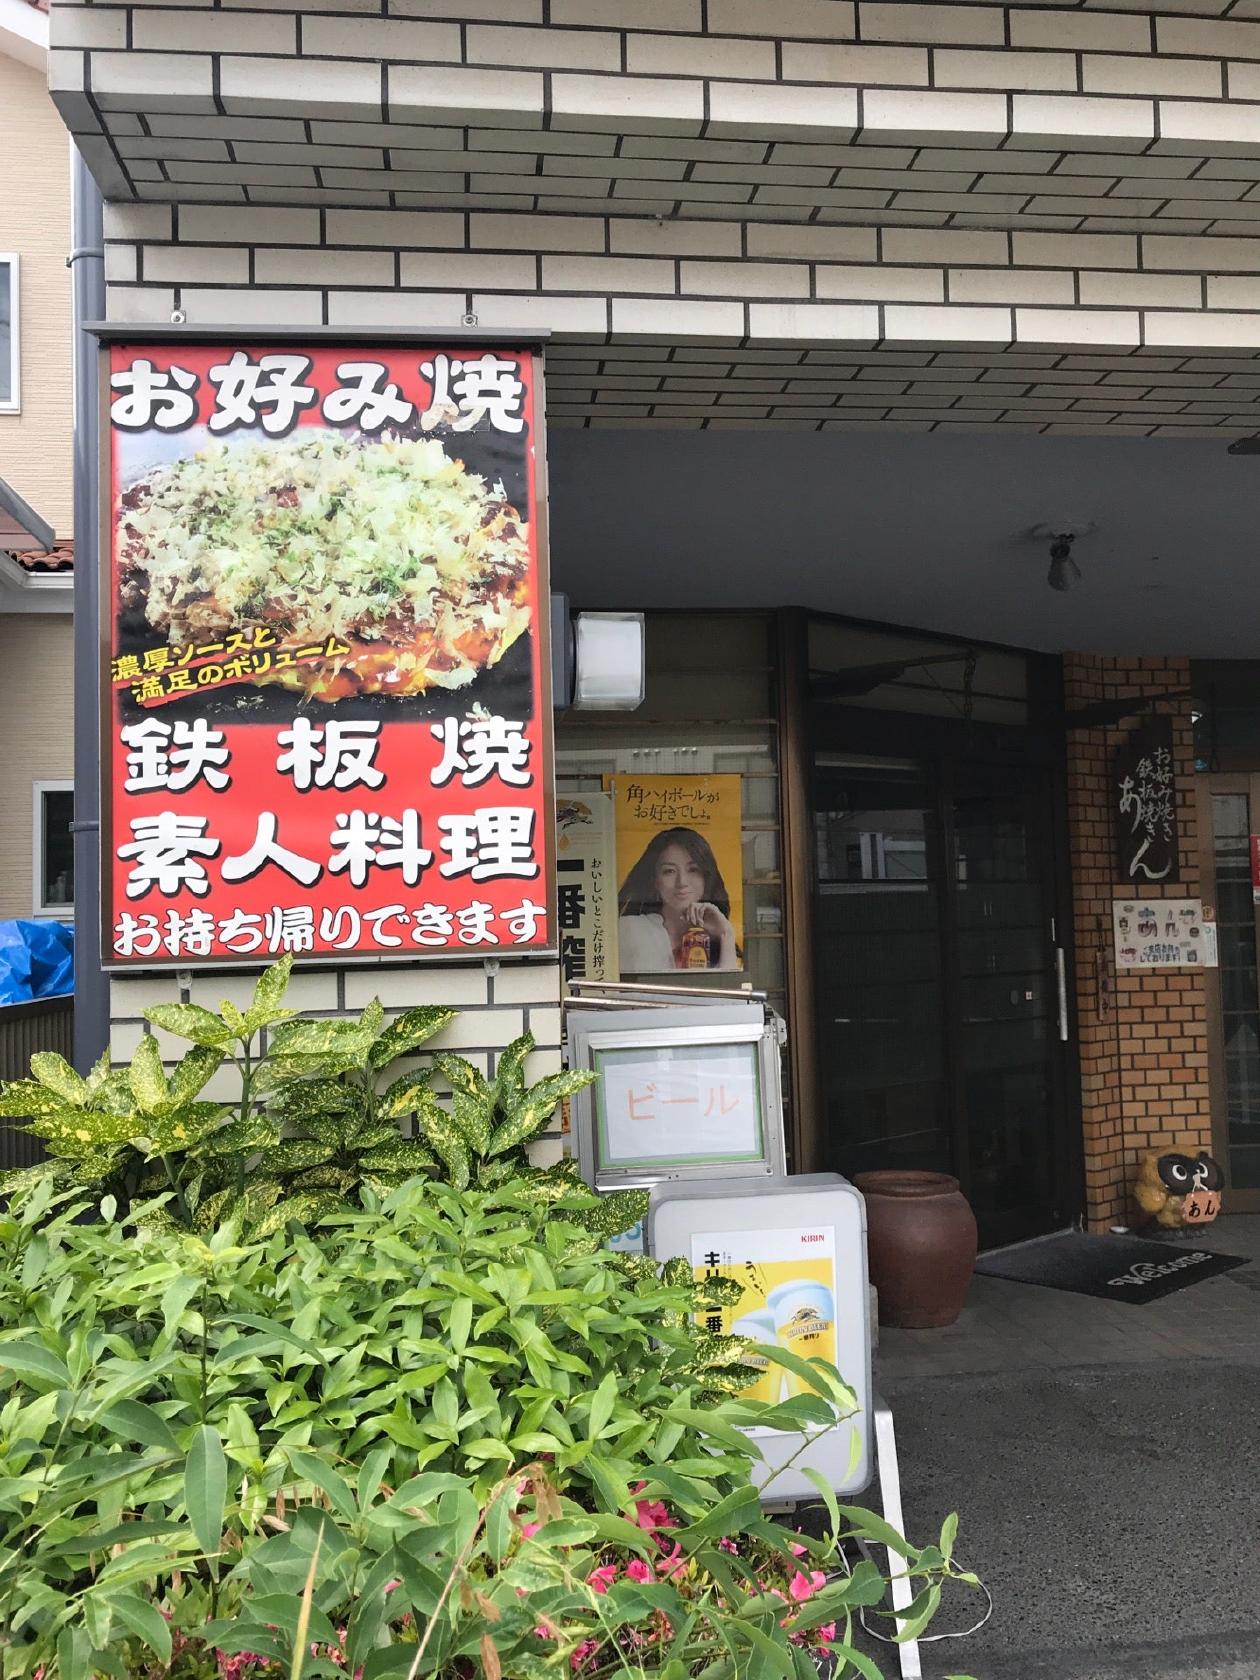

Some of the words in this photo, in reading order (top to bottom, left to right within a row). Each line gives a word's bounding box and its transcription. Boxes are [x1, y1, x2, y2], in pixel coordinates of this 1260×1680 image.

[110, 351, 525, 434] お好み焼
[111, 627, 277, 683] 濃厚ソースと
[131, 638, 351, 704] 満足のボリューム
[120, 716, 533, 793] 鉄板焼
[626, 783, 720, 804] 角ハイボールが
[1153, 746, 1175, 842] お好み焼き
[117, 807, 539, 899] 素人料理
[113, 898, 547, 957] お持ち帰りできます
[591, 857, 606, 995] おいしいとこだけ搾っ、
[626, 1082, 740, 1121] ビール
[801, 1234, 825, 1243] KIRIN
[1188, 1200, 1216, 1218] あん
[1106, 1251, 1213, 1287] Welcome
